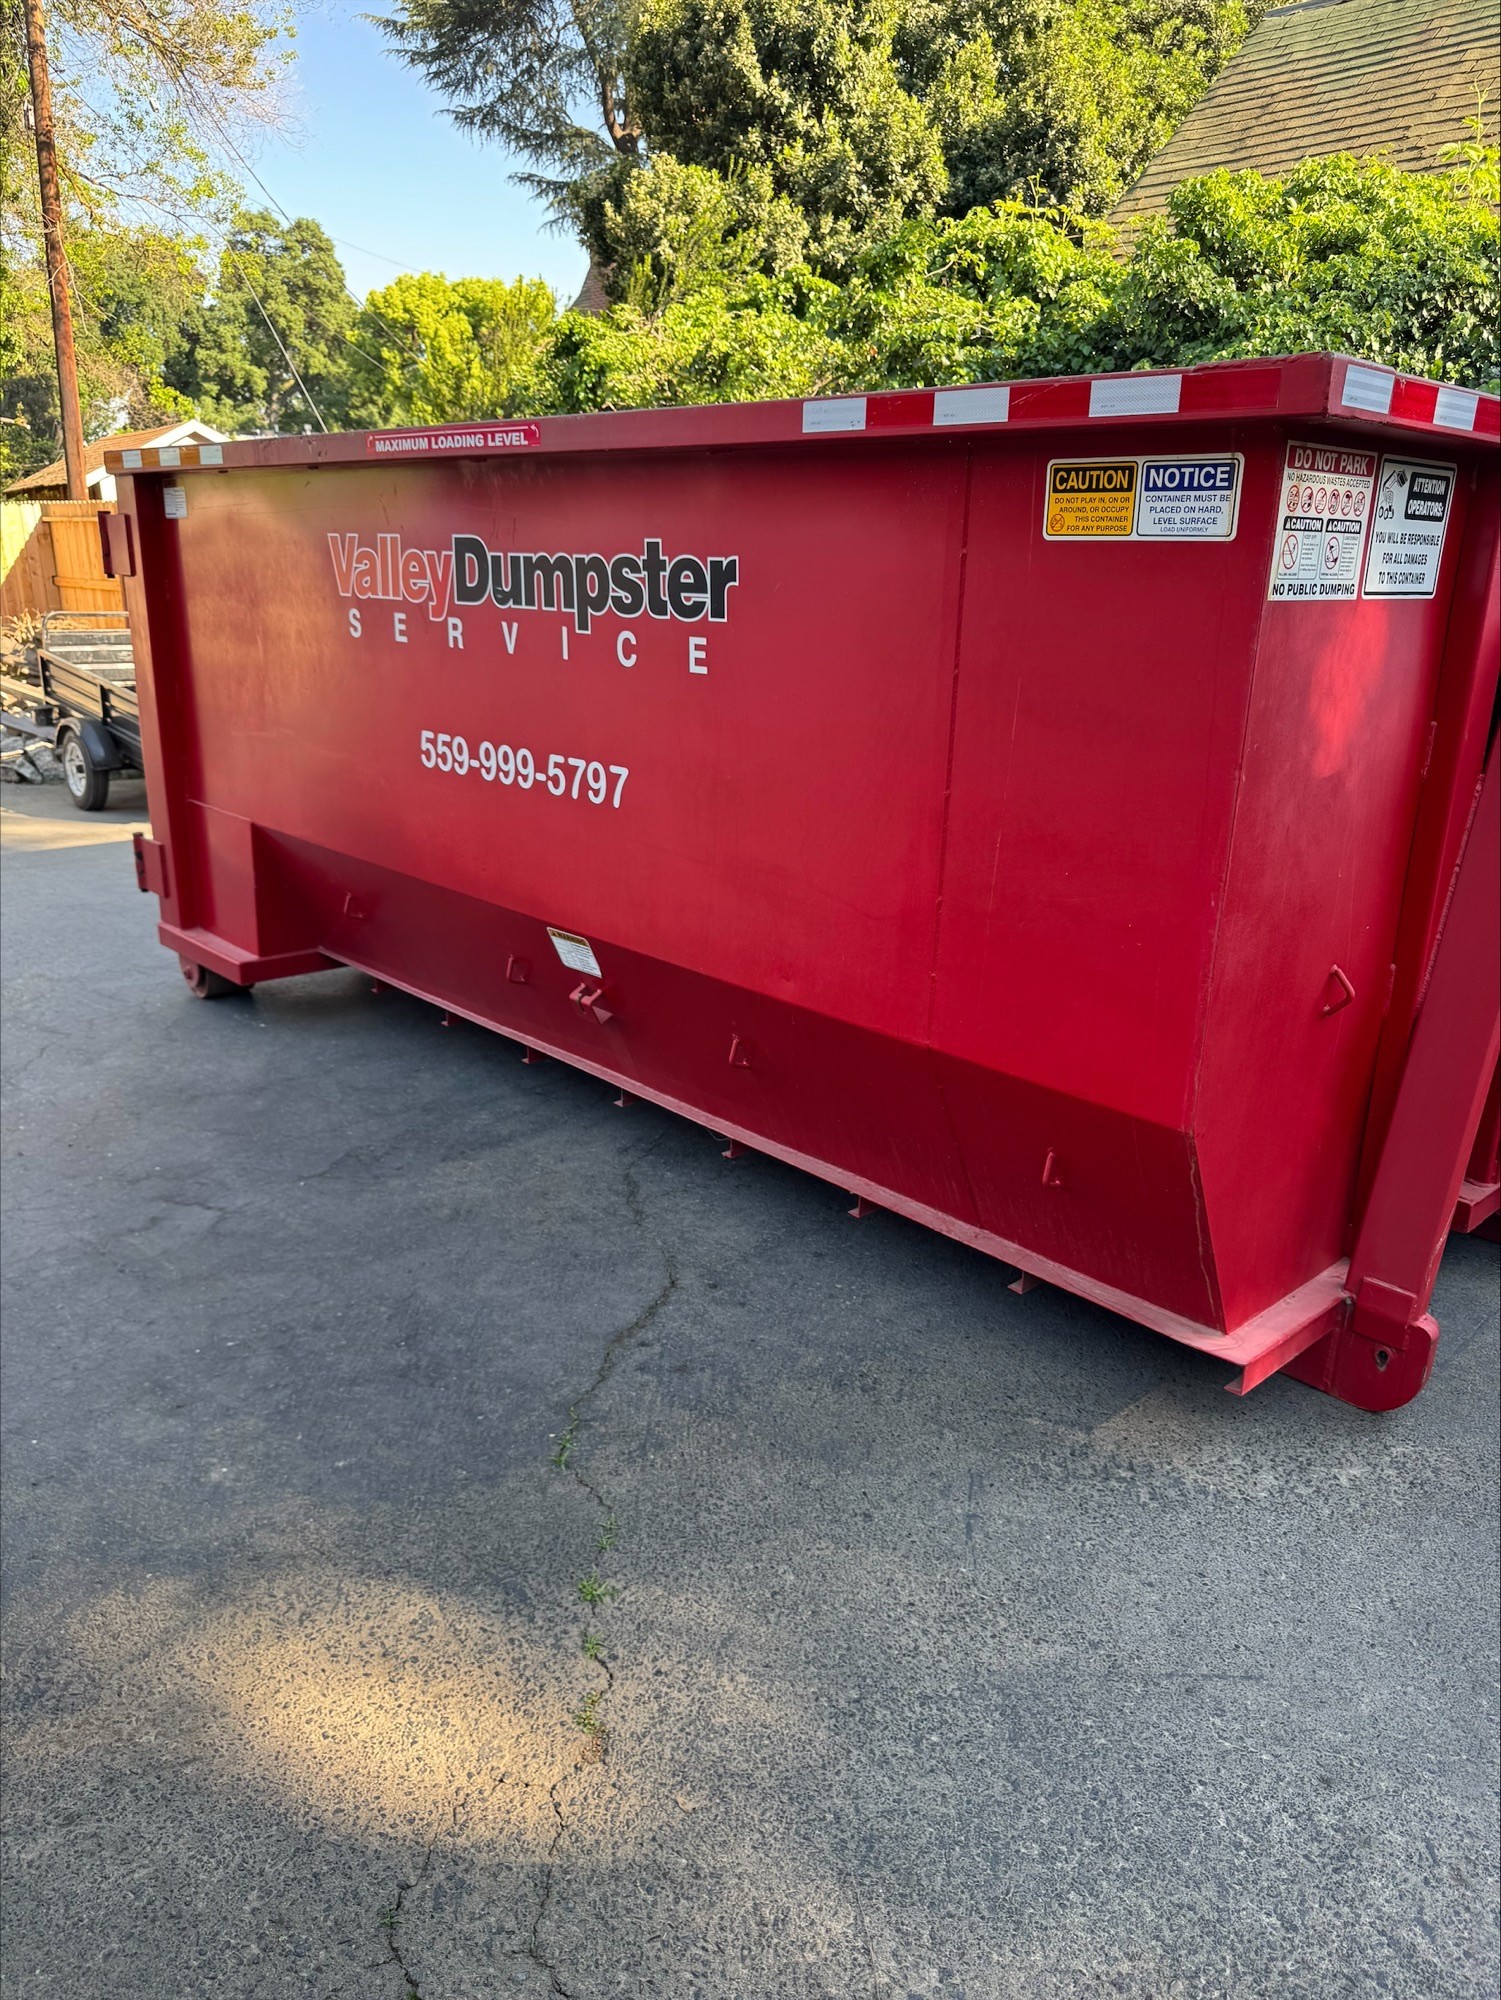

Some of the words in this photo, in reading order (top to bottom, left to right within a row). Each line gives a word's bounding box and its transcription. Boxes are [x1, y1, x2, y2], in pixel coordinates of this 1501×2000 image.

[375, 437, 429, 452] MAXIMUM
[431, 434, 484, 449] LOADING
[487, 432, 528, 447] LEVEL
[1294, 448, 1312, 469] DO
[1314, 450, 1338, 471] NOT
[1340, 454, 1369, 475] PARK
[1055, 470, 1129, 490] CAUTION
[1149, 466, 1231, 488] NOTICE
[1287, 472, 1295, 481] NO
[1296, 472, 1327, 485] HAZARDOUS
[1326, 476, 1346, 487] WASTES
[1346, 478, 1371, 489] ACCEPTED
[1413, 477, 1447, 495] ATTENTION
[1145, 494, 1192, 503] CONTAINER
[1193, 494, 1218, 503] MUST
[1219, 494, 1231, 502] BE
[1059, 506, 1089, 514] AROUND,
[1149, 506, 1183, 514] PLACED
[1184, 506, 1196, 514] ON
[1198, 506, 1224, 515] HARD,
[1090, 515, 1128, 523] CONTAINER
[1153, 517, 1177, 525] LEVEL
[1179, 517, 1218, 525] SURFACE
[1290, 518, 1322, 531] CAUTION
[1332, 520, 1361, 533] CAUTION
[1375, 531, 1386, 544] YOU
[1387, 532, 1399, 544] WILL
[1399, 533, 1407, 545] BE
[1407, 533, 1440, 546] RESPONSIBLE
[1382, 552, 1393, 564] FOR
[1393, 552, 1403, 565] ALL
[1403, 553, 1428, 565] DAMAGES
[1378, 571, 1386, 584] TO
[1386, 572, 1398, 584] THIS
[1398, 572, 1425, 585] CONTAINER
[1272, 583, 1285, 595] NO
[1287, 583, 1318, 595] PUBLIC
[1319, 583, 1355, 595] DUMPING
[419, 729, 630, 808] 559-999-5797
